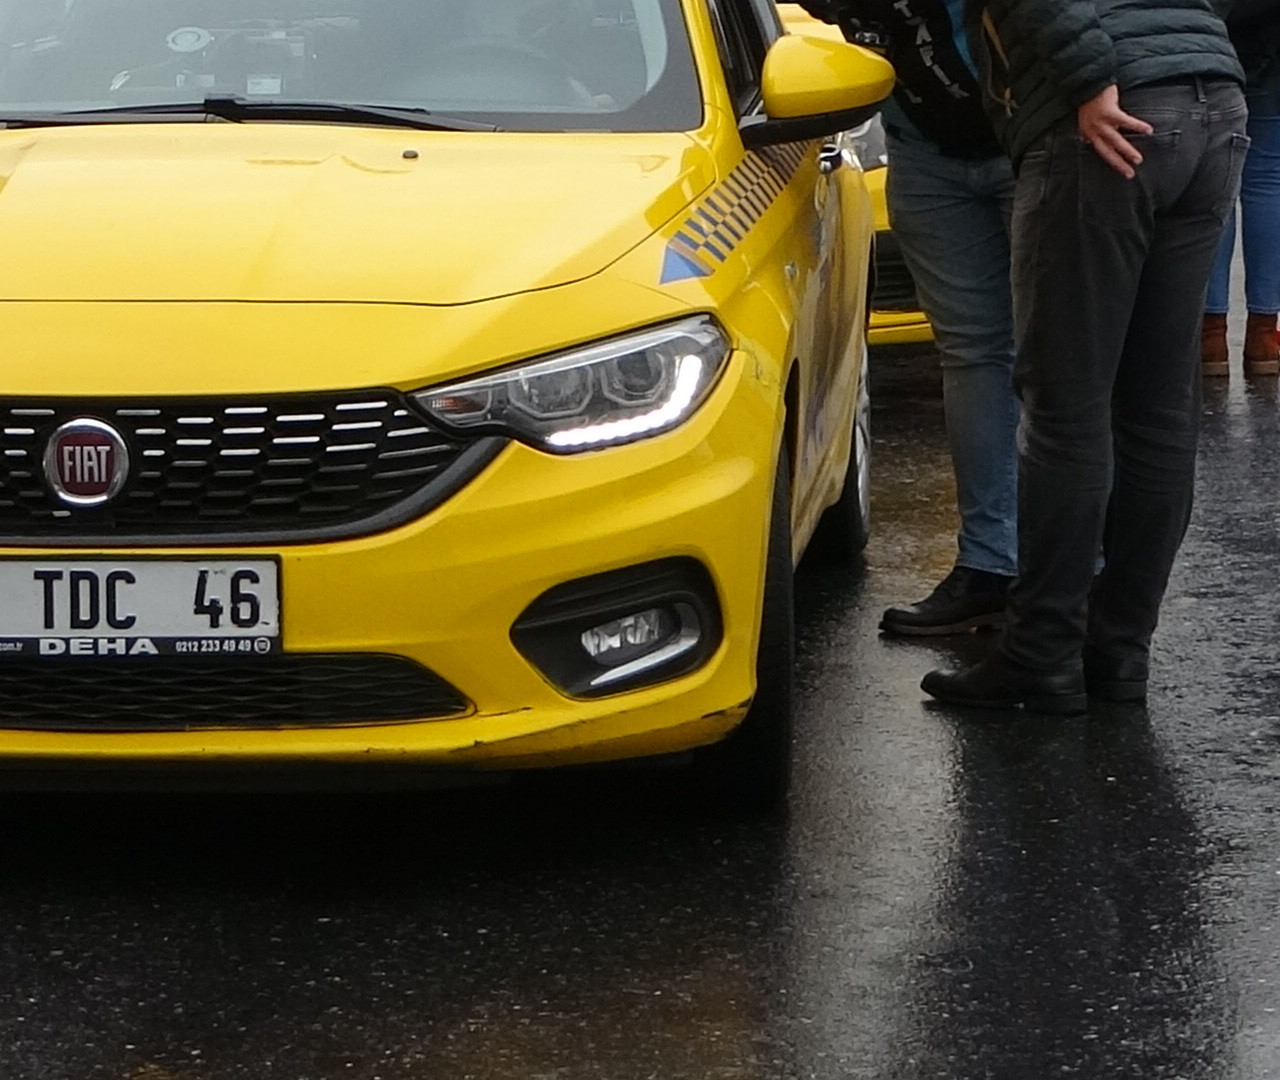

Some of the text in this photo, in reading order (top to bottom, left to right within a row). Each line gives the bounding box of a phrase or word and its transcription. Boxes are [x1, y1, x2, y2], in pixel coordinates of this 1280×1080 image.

[63, 446, 111, 483] FIAT
[33, 569, 137, 630] TDC
[193, 569, 261, 629] 46
[38, 638, 159, 656] DEHA
[176, 641, 199, 652] 0212
[201, 639, 220, 652] 233
[222, 639, 236, 651] 49
[238, 639, 252, 651] 49
